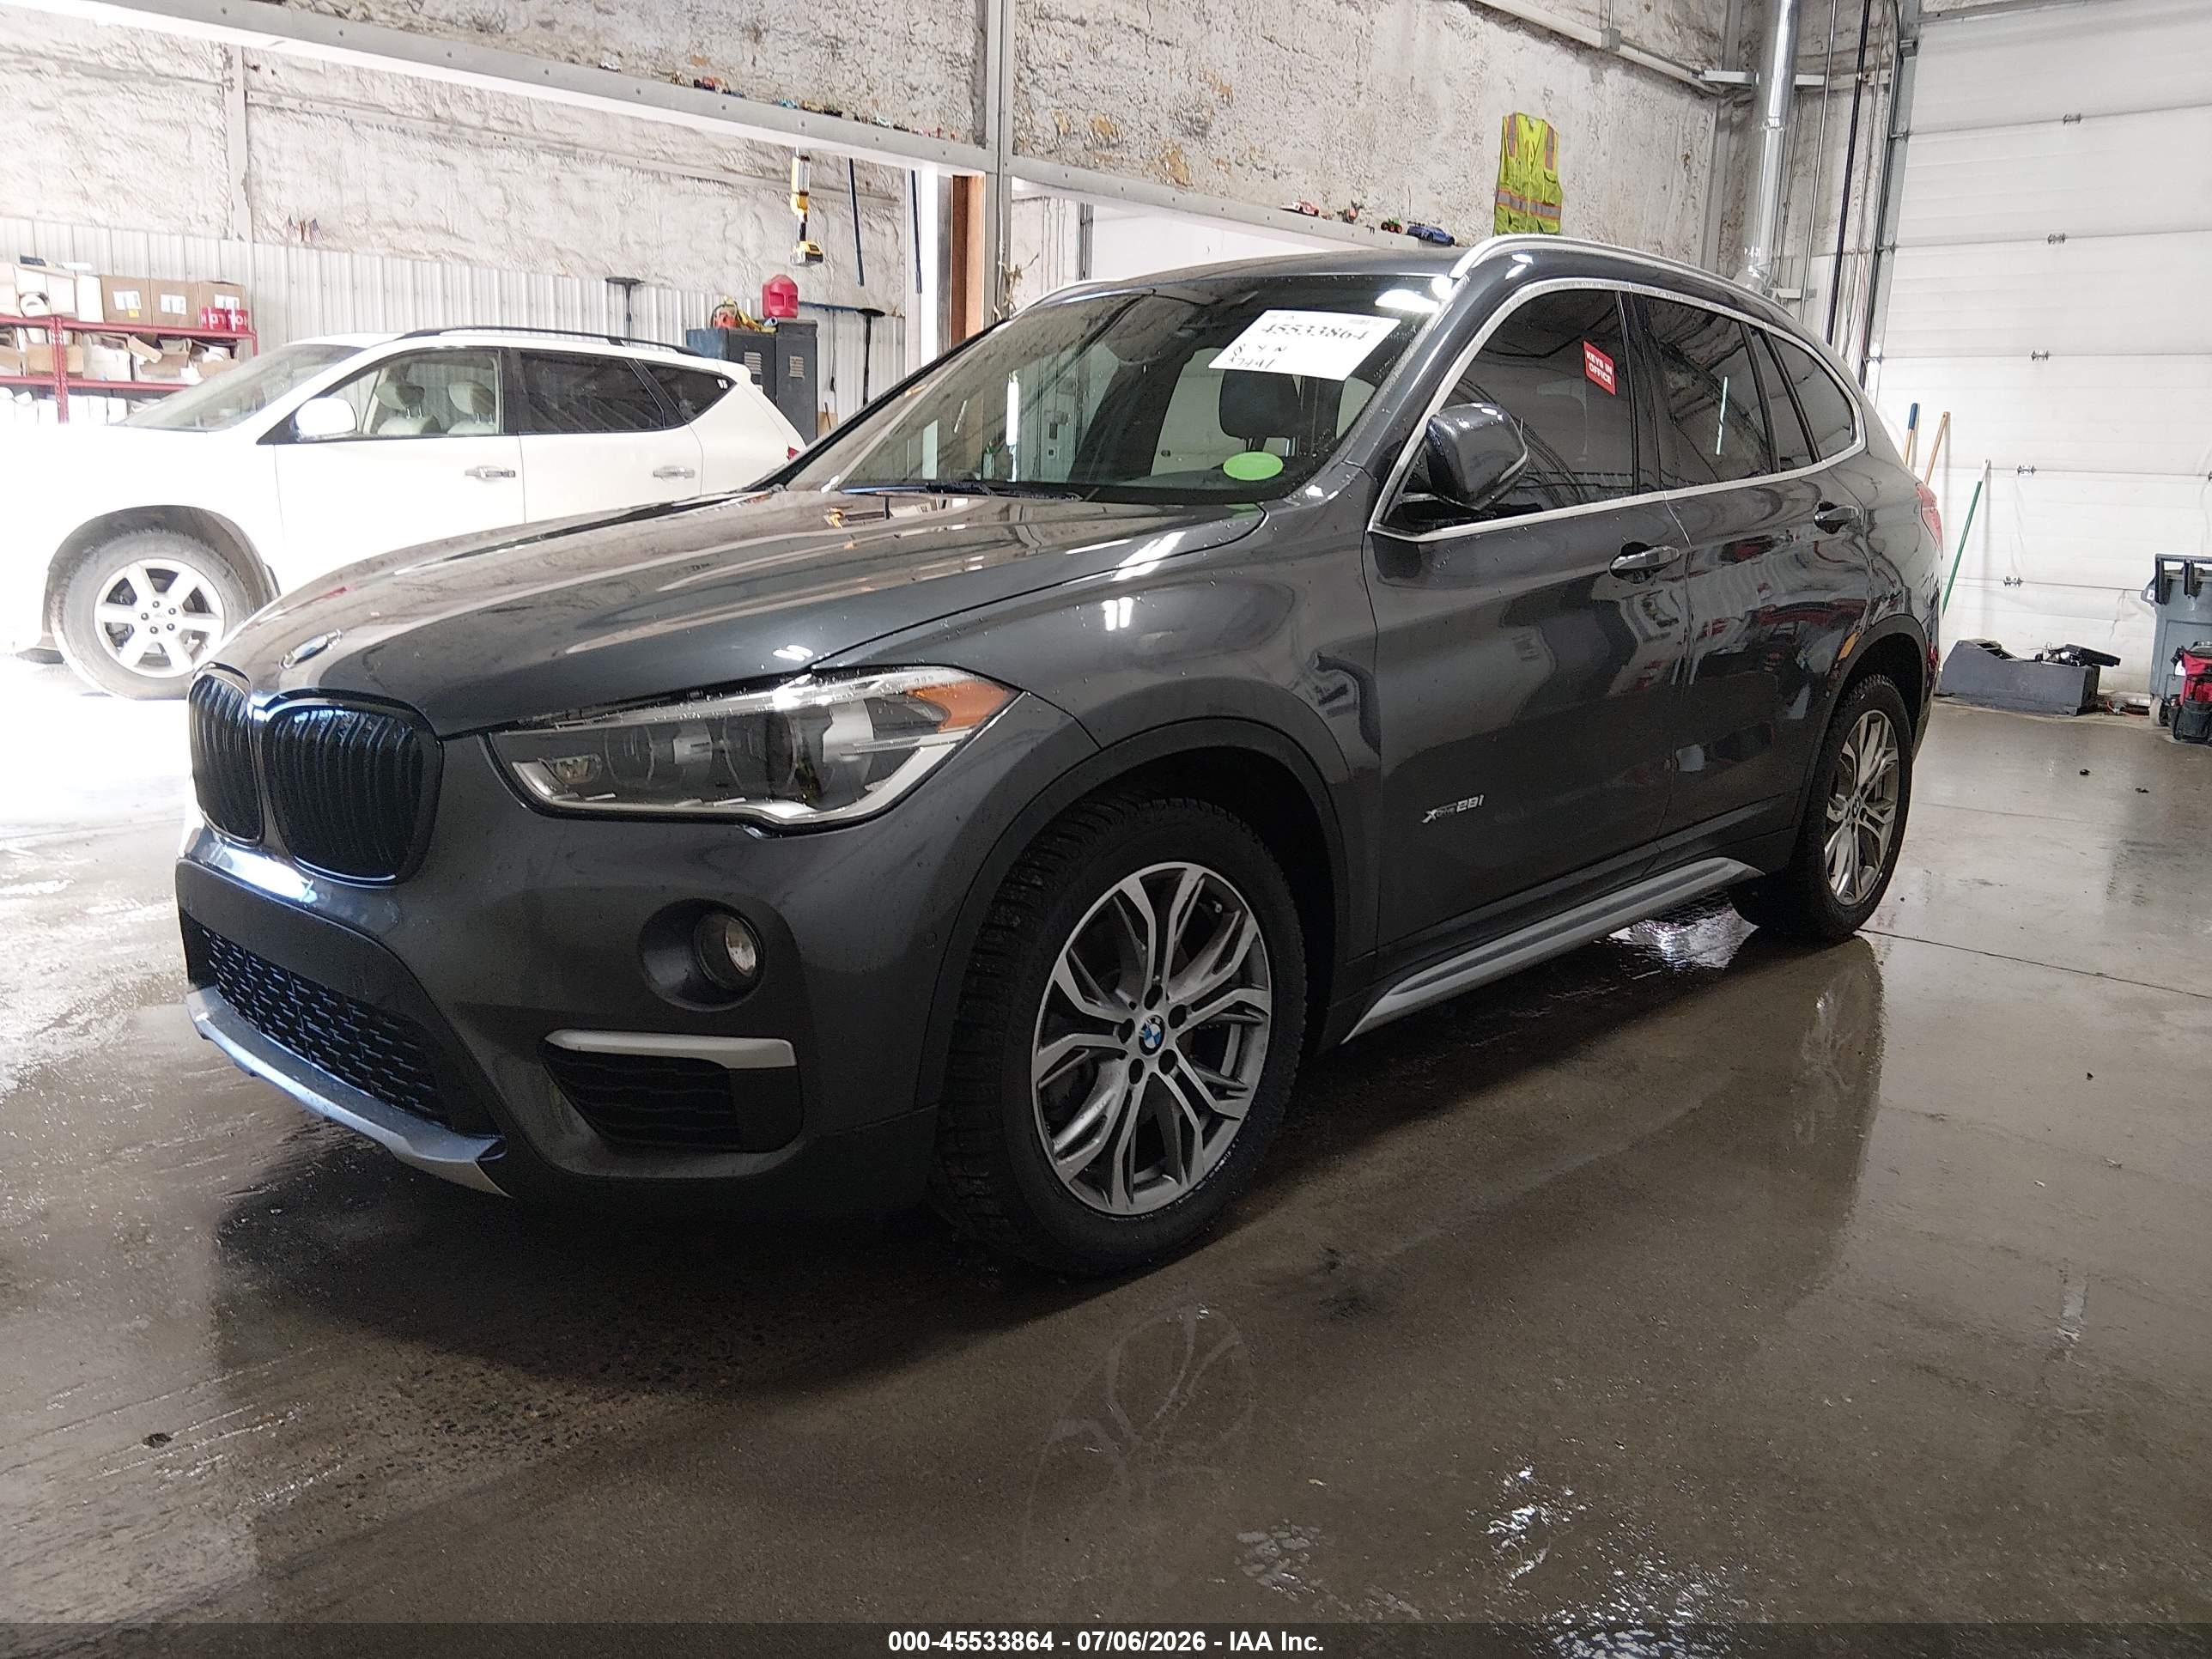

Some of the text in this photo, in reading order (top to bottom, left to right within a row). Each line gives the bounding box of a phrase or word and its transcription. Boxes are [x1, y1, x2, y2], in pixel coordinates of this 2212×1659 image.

[1586, 349, 1613, 376] KEYS IN
[1589, 362, 1612, 386] OFFICE
